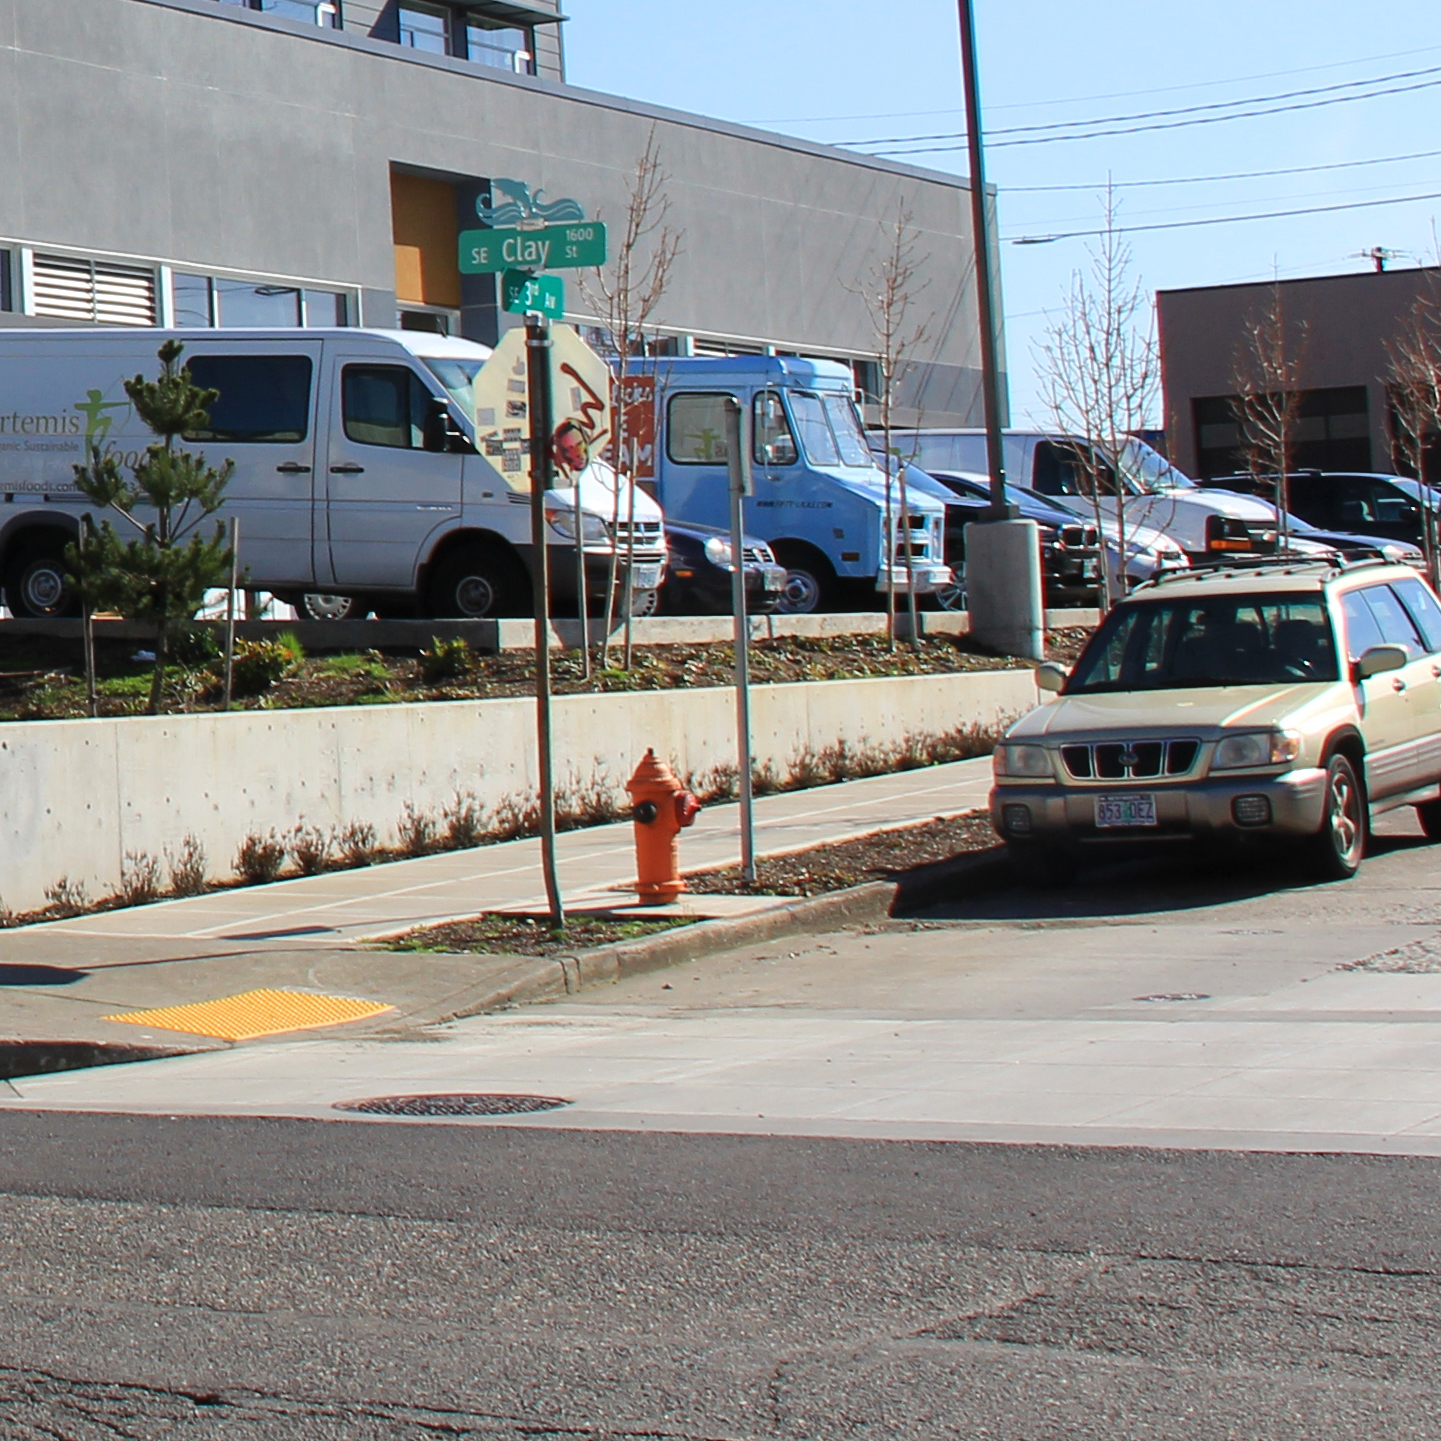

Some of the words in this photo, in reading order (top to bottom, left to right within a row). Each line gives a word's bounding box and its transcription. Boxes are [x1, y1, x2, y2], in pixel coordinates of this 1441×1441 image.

[471, 247, 489, 265] SE
[501, 236, 550, 265] Clay
[565, 228, 594, 242] 1600
[565, 245, 577, 259] St
[509, 286, 519, 304] SE
[24, 441, 79, 452] Sustainable
[1098, 803, 1121, 821] 853
